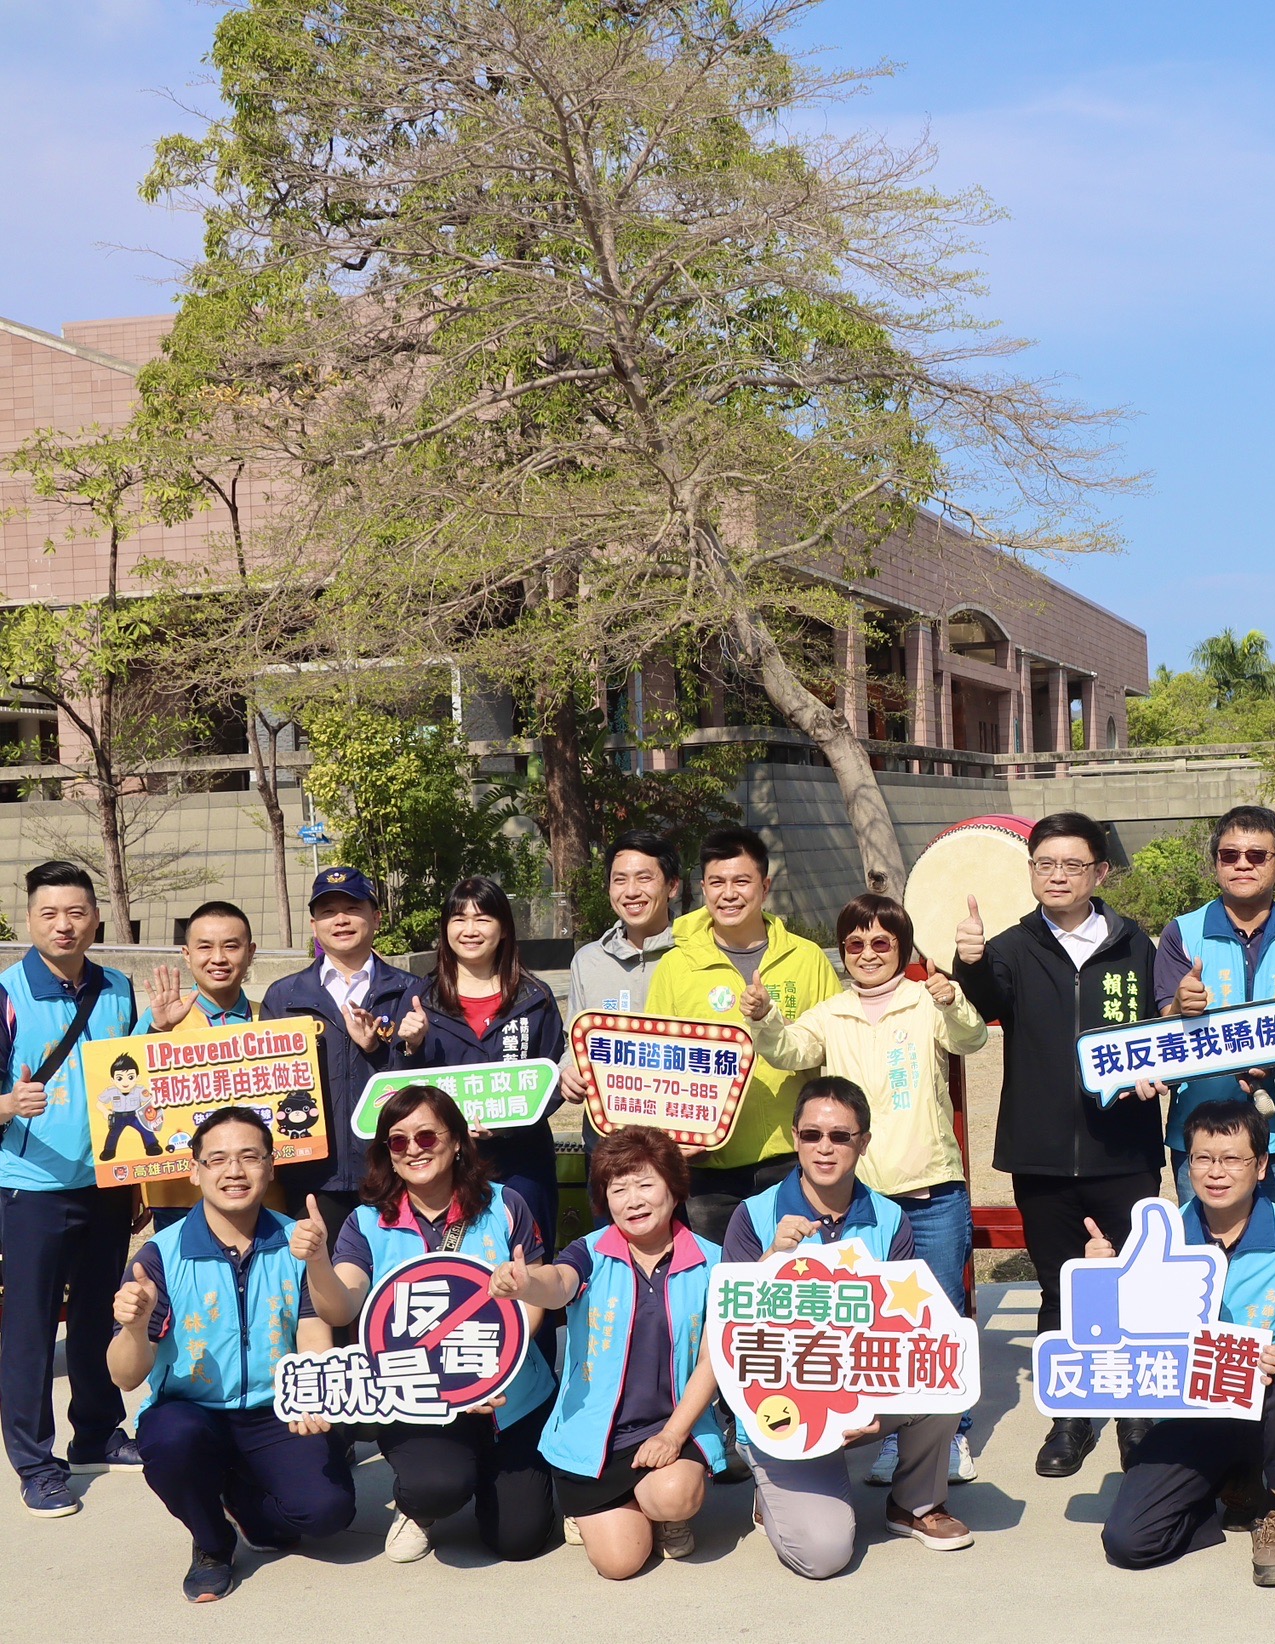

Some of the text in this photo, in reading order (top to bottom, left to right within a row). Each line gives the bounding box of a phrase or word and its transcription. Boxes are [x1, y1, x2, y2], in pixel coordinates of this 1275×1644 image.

[1102, 972, 1124, 1022] 賴瑞
[1126, 971, 1138, 1022] 立法委員
[147, 1031, 305, 1068] I Prevent Crime
[588, 1037, 738, 1077] 毒防諮詢專線
[150, 1061, 312, 1106] 預防犯罪由我做起
[606, 1073, 718, 1100] 0800-770-885
[887, 1048, 911, 1111] 李喬如
[718, 1281, 871, 1323] 拒絕毒品
[182, 1312, 213, 1384] 林哲民
[737, 1328, 961, 1390] 青春無敵
[1046, 1330, 1260, 1409] 反毒雄 讚
[282, 1346, 449, 1417] 這就是
